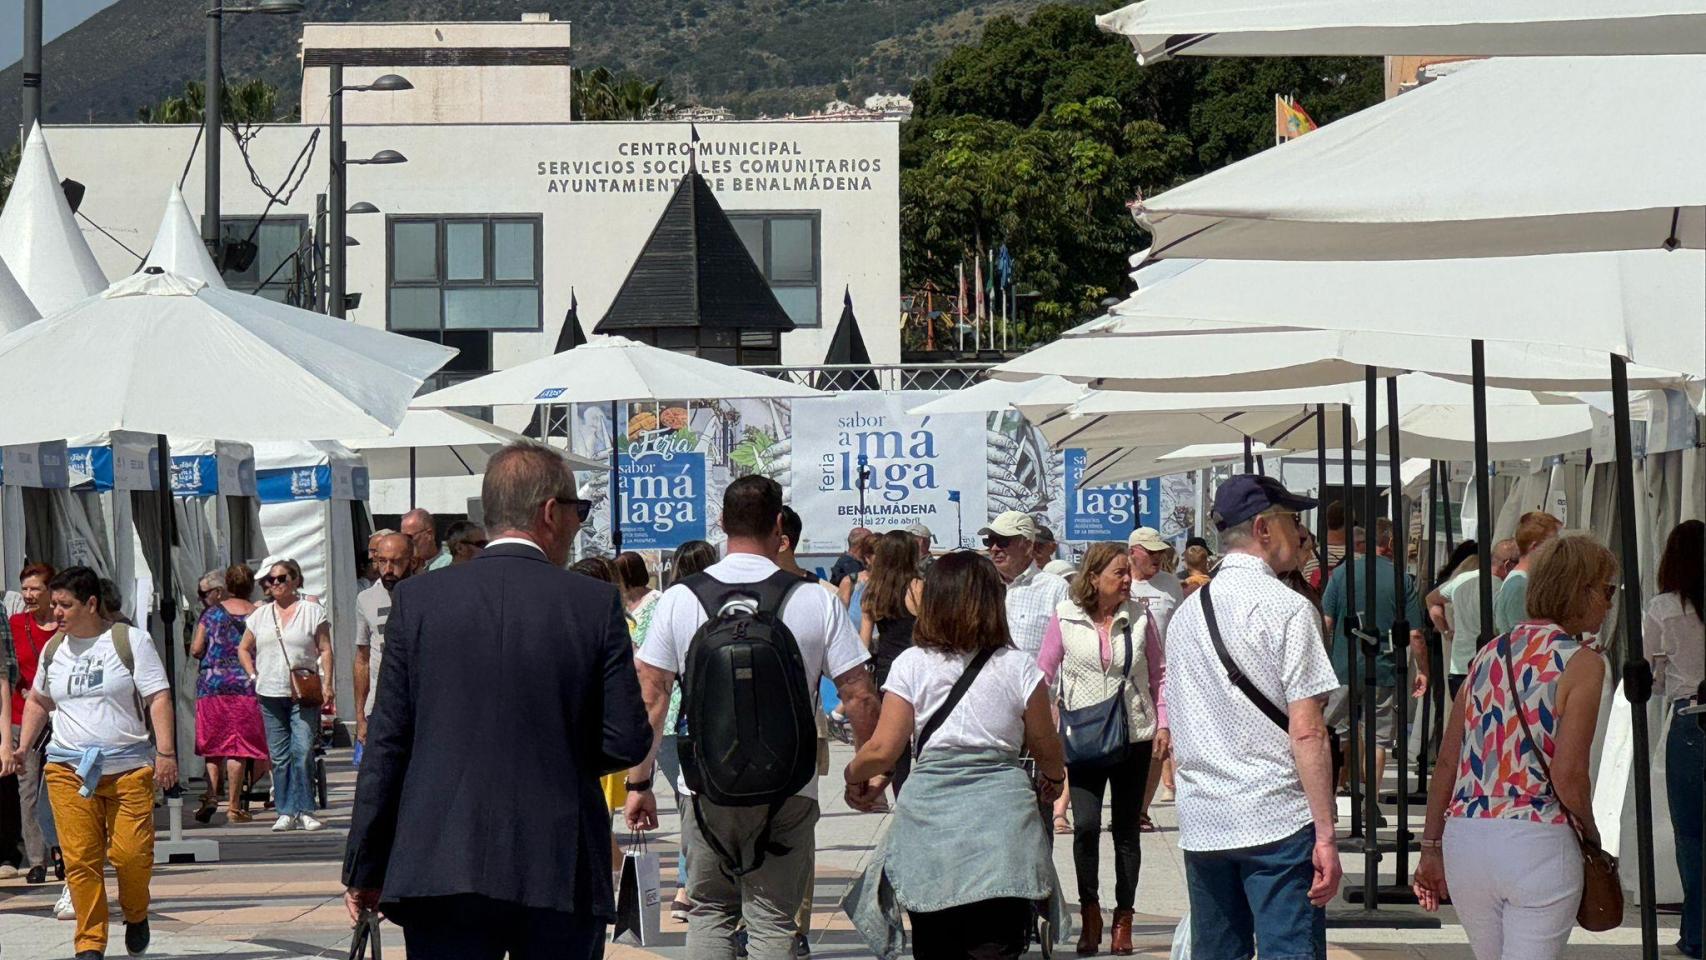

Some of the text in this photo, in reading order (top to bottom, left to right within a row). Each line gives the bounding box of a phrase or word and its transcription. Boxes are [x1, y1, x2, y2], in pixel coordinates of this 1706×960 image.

[618, 141, 802, 156] CENTRO MUNICIPAL
[537, 159, 881, 175] SERVICIOS SOCILES COMUNITARIOS
[548, 178, 682, 193] AYUNTAMIENT
[733, 173, 872, 192] BENALMÁDENA
[838, 411, 886, 428] sabor
[628, 427, 692, 461] Feria
[856, 415, 940, 460] má
[619, 460, 656, 474] sabor
[819, 453, 835, 493] feria
[631, 463, 697, 499] má
[619, 491, 697, 532] laga
[838, 502, 937, 521] BENALMÁDENA
[875, 517, 886, 525] 27
[888, 517, 899, 525] de
[900, 516, 921, 526] abril
